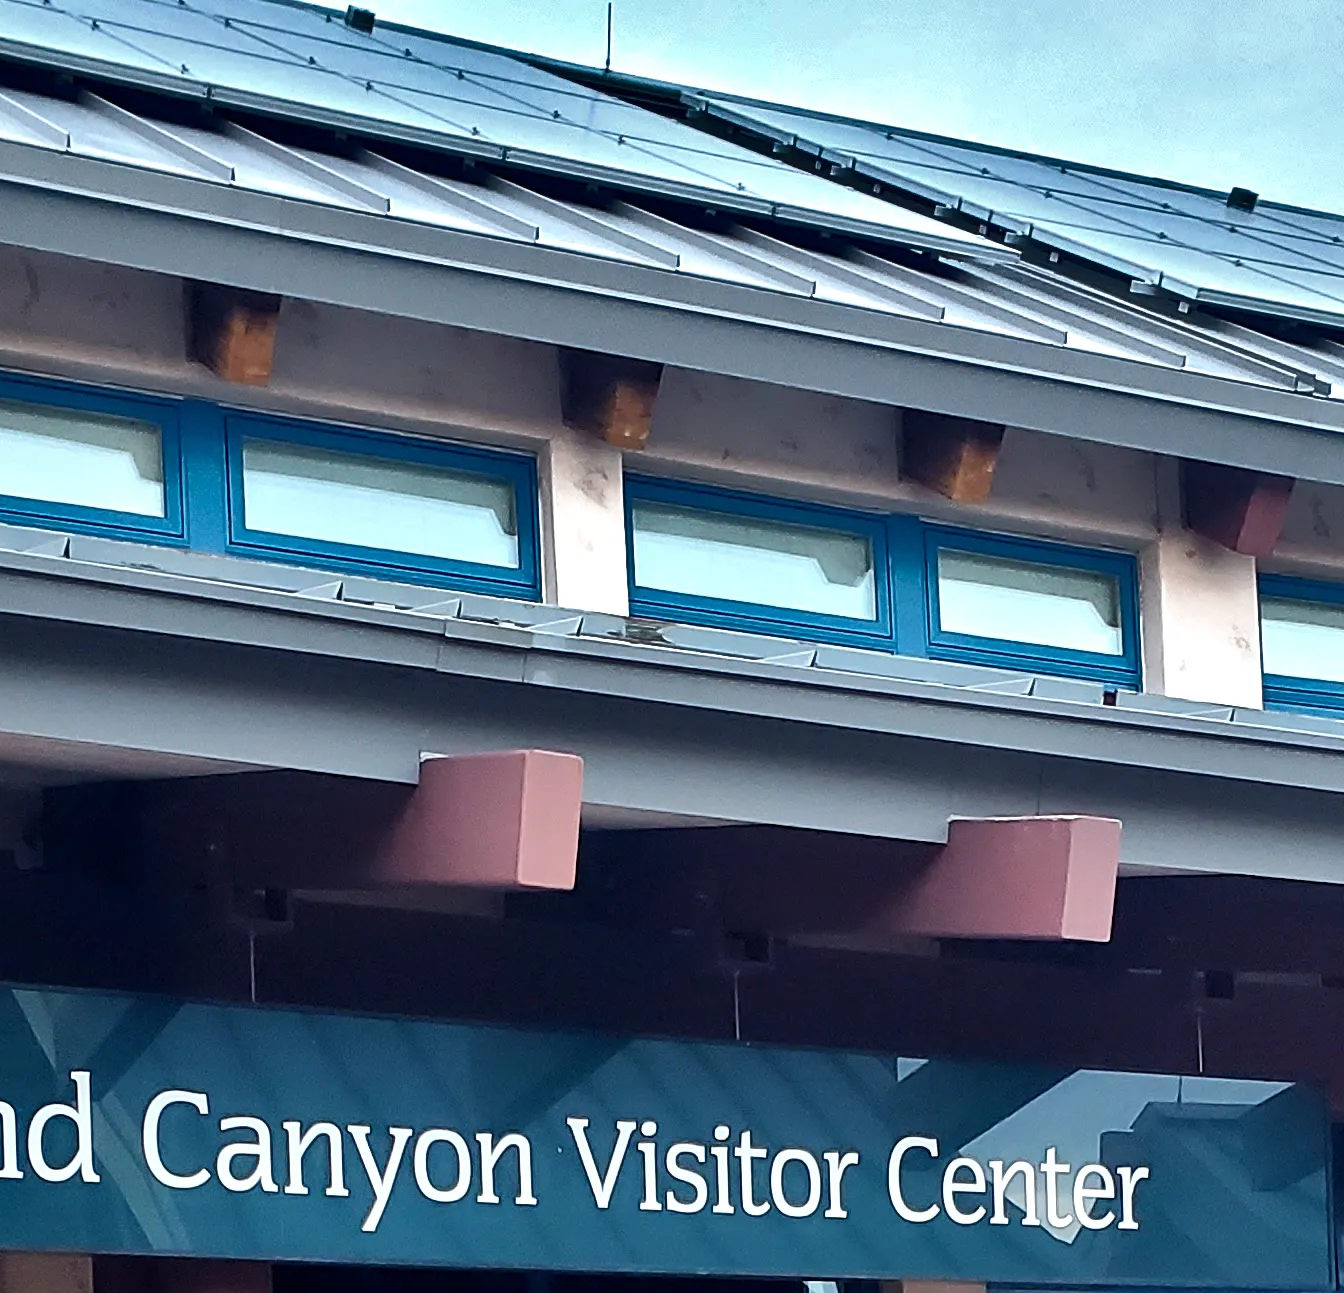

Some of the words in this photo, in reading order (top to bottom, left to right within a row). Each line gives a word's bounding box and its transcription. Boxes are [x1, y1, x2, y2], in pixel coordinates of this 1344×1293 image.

[141, 1088, 538, 1233] Canyon
[565, 1117, 860, 1220] Visitor
[886, 1135, 1150, 1231] Center
